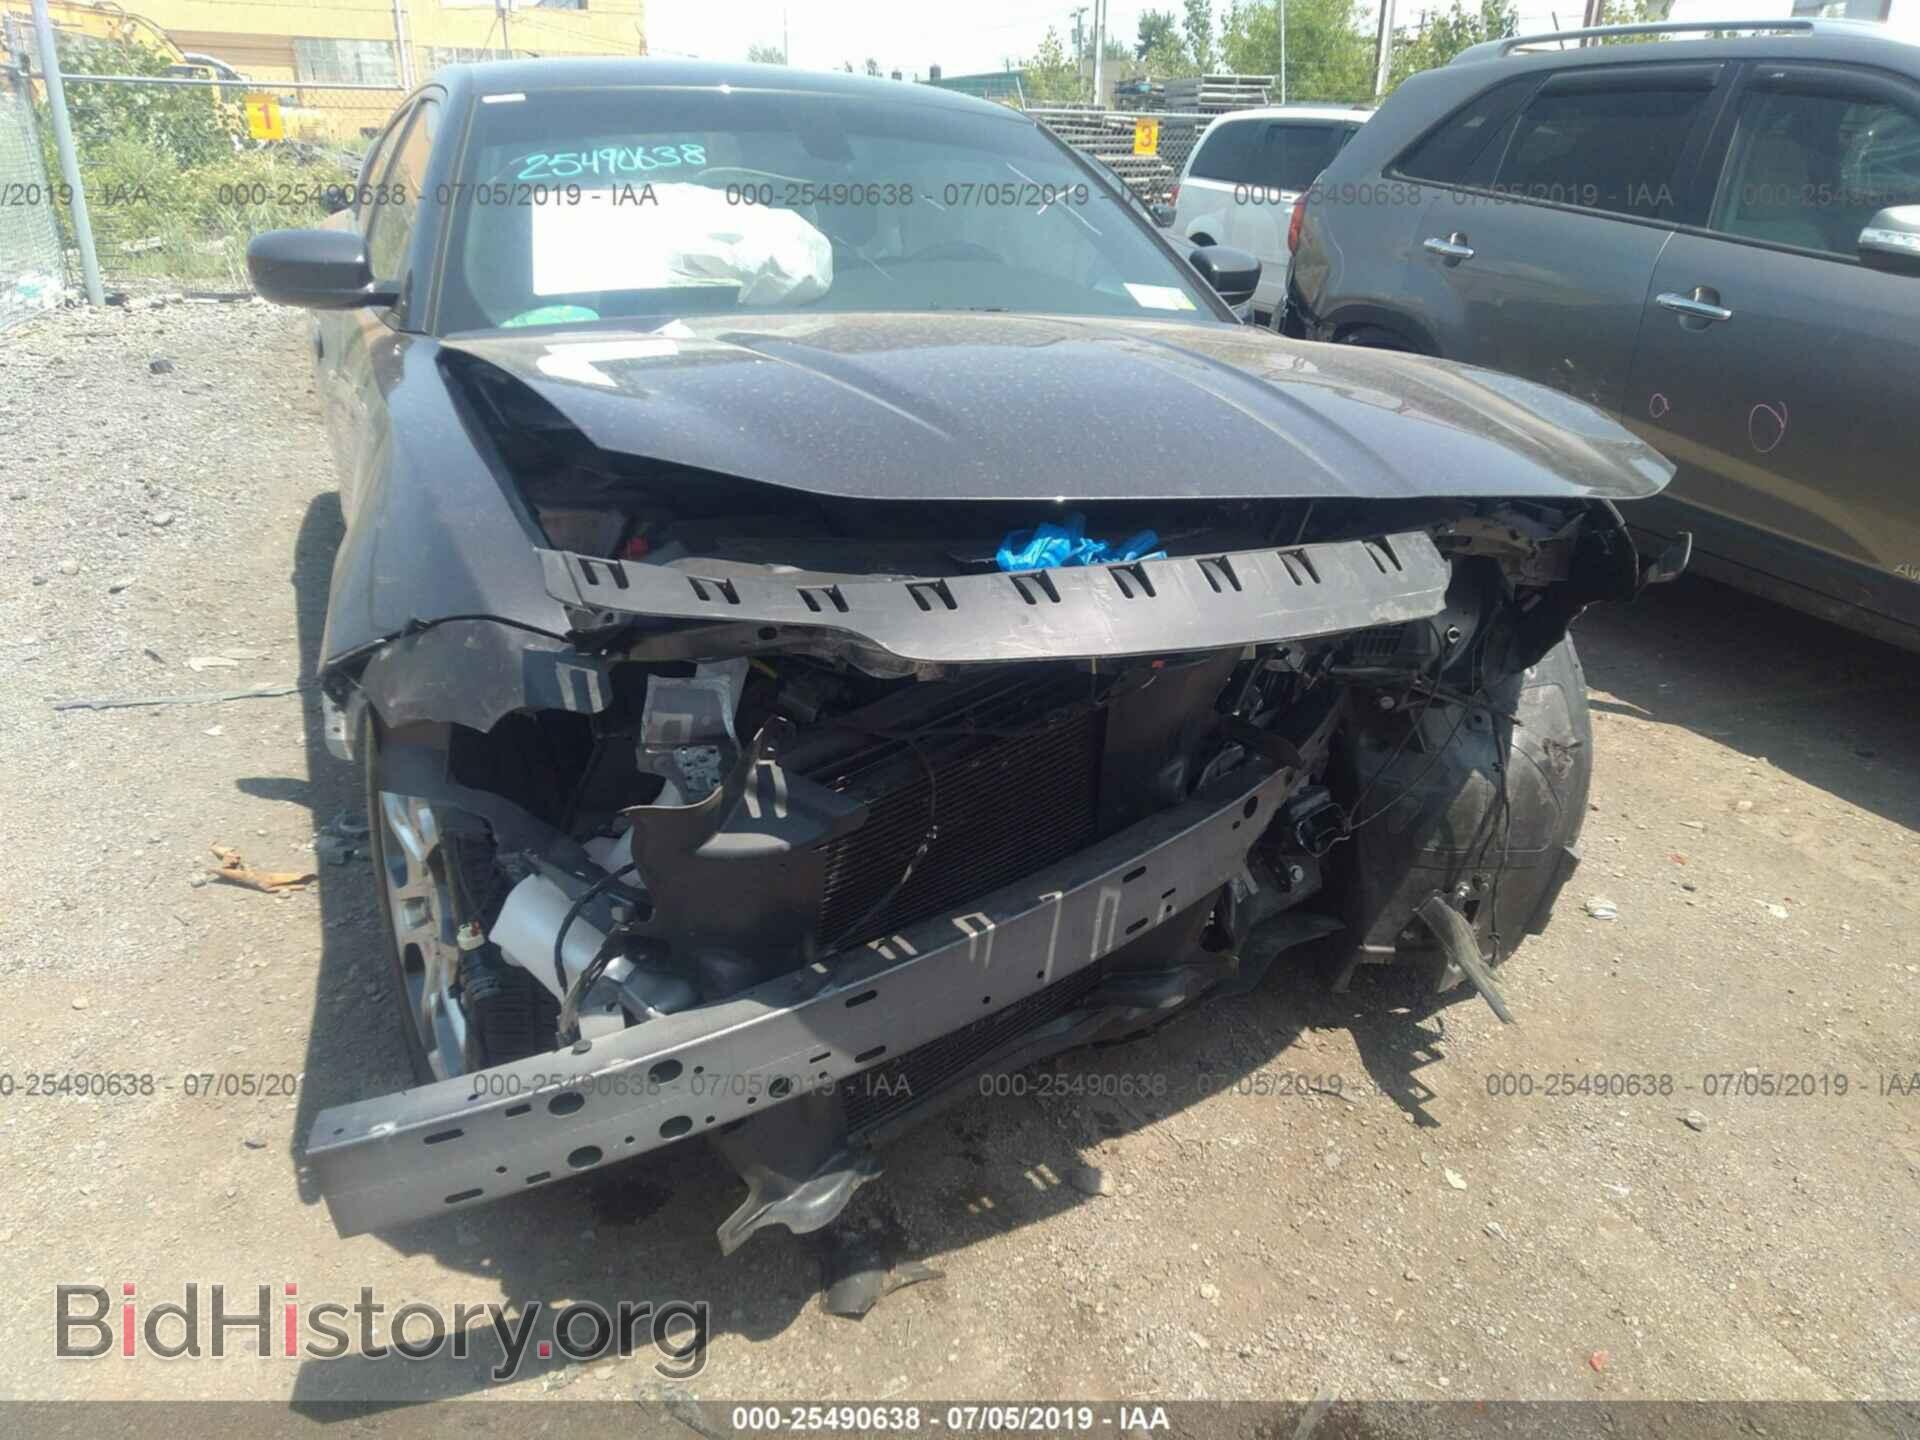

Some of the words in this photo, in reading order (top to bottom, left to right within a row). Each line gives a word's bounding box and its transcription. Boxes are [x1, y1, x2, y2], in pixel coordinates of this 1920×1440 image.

[258, 103, 272, 129] 1
[1141, 125, 1152, 147] 3
[517, 144, 706, 179] 25490638
